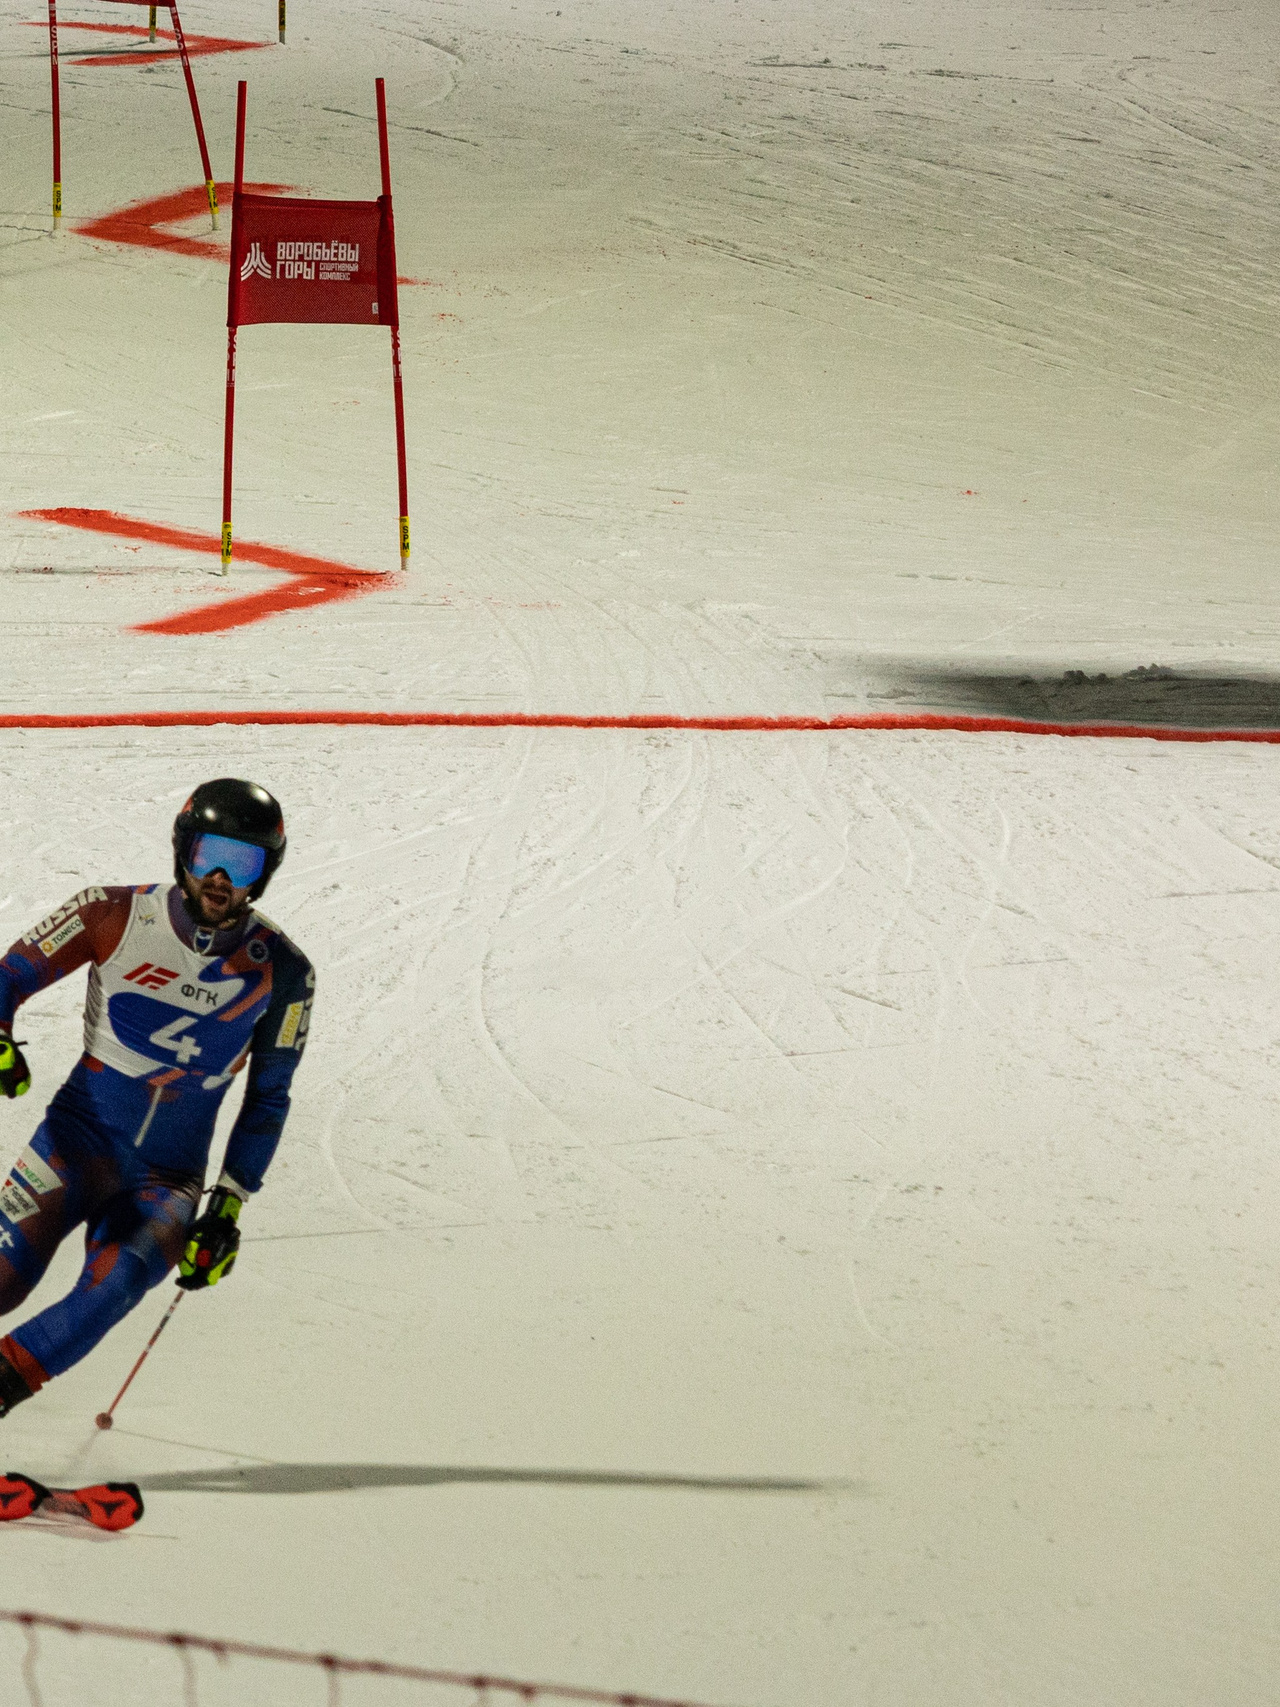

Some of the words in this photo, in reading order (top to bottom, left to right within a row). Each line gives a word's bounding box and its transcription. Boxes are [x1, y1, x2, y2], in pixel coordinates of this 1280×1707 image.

[276, 240, 360, 262] ВОРОБЬЁВЫ
[275, 261, 315, 281] ГОРЫ
[181, 983, 219, 1007] ФГК
[149, 1015, 202, 1064] 4
